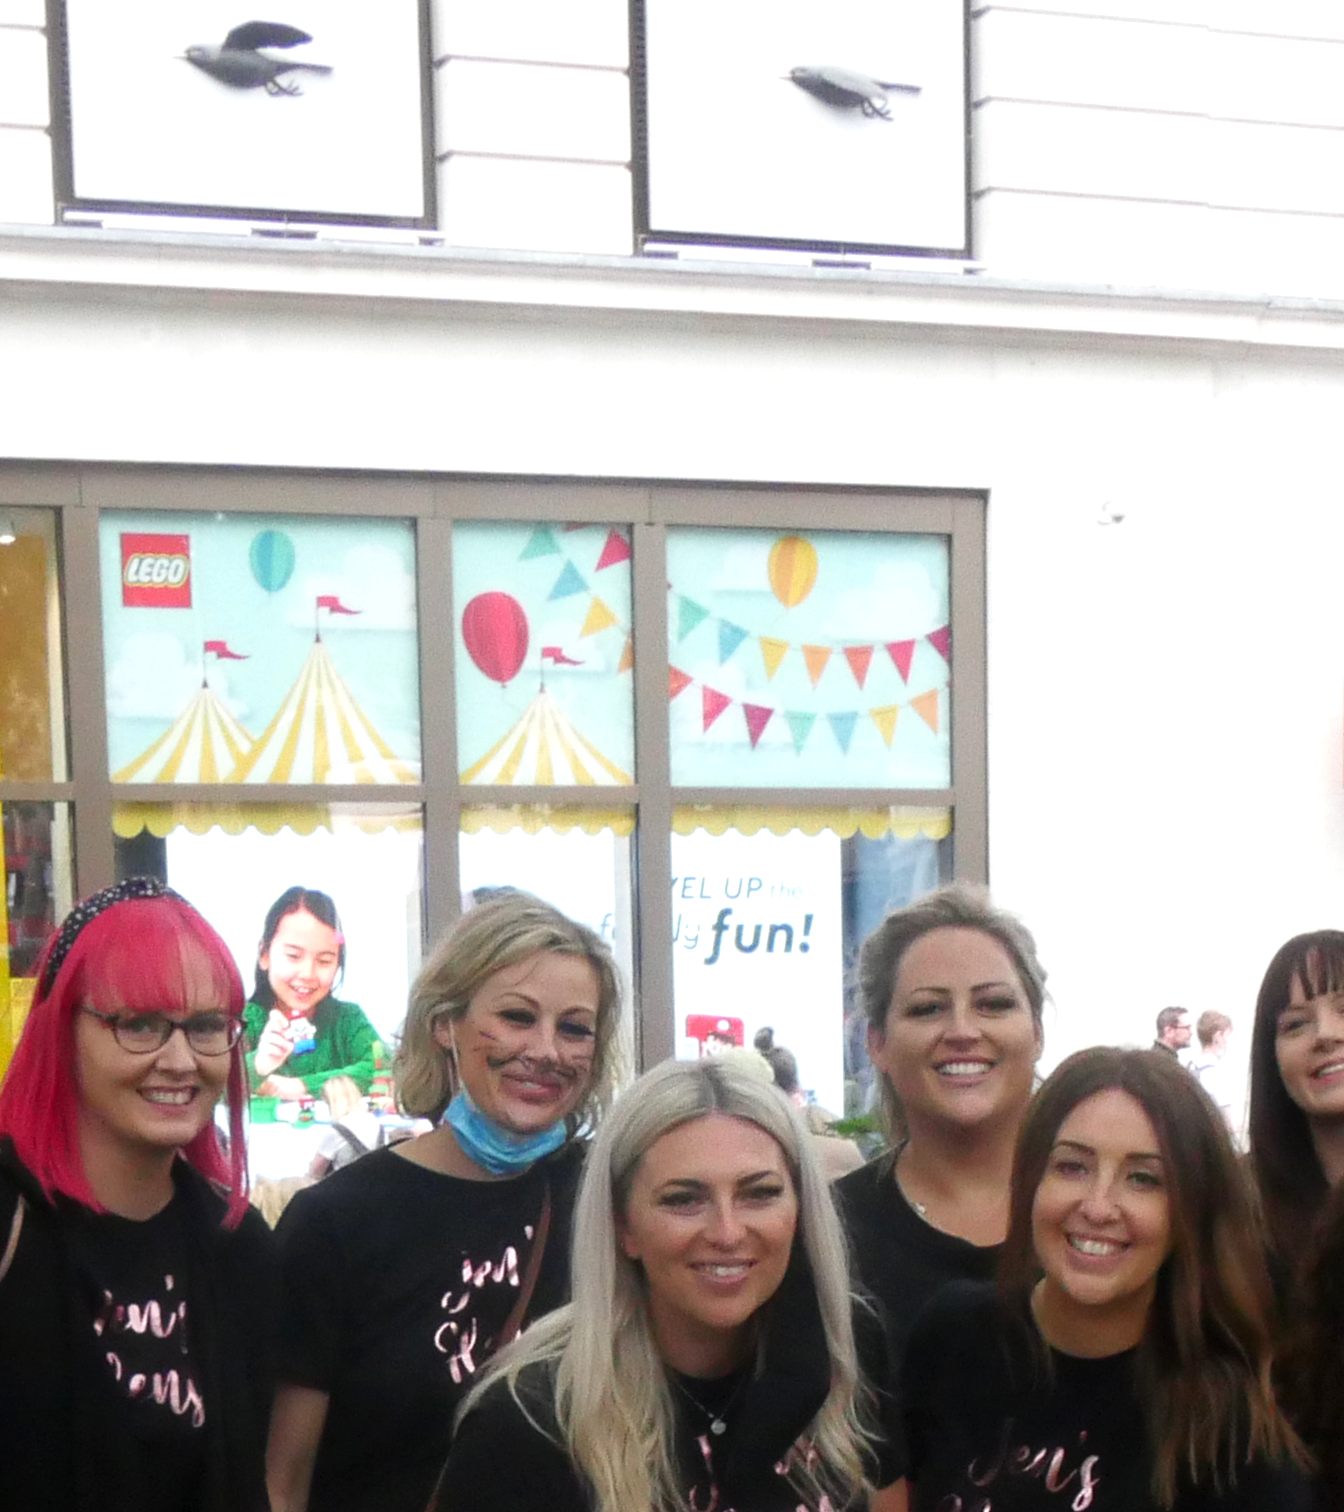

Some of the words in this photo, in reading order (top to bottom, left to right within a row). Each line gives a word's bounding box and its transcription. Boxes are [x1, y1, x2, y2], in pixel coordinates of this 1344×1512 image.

[126, 555, 187, 585] LEGO
[725, 876, 763, 899] UP
[703, 907, 814, 966] fun!
